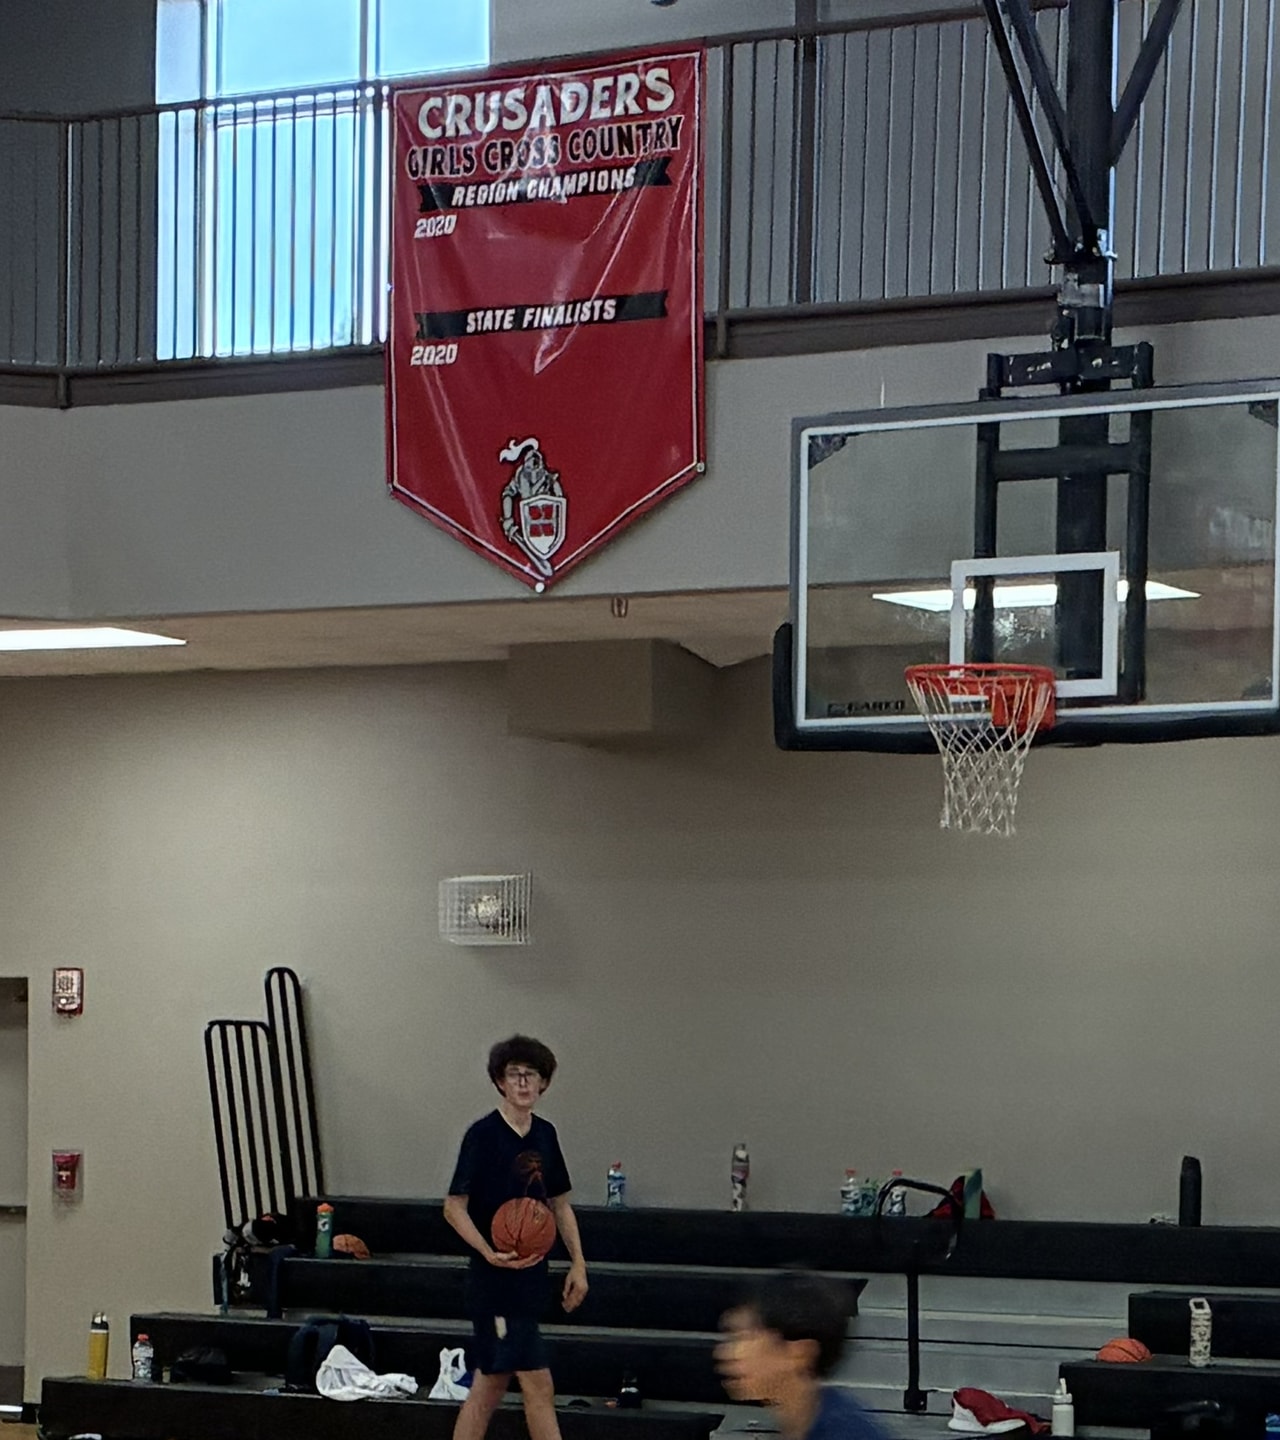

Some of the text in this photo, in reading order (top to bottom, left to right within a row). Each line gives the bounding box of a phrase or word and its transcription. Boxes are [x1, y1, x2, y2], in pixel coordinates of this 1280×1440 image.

[418, 67, 675, 139] CRUSADERS
[407, 116, 684, 179] GIRLS CROSS COUNTRY
[451, 165, 636, 207] REGION CHAMPIONS
[414, 215, 456, 238] 2020
[466, 298, 618, 333] STATE FINALISTS
[410, 343, 458, 366] 2020
